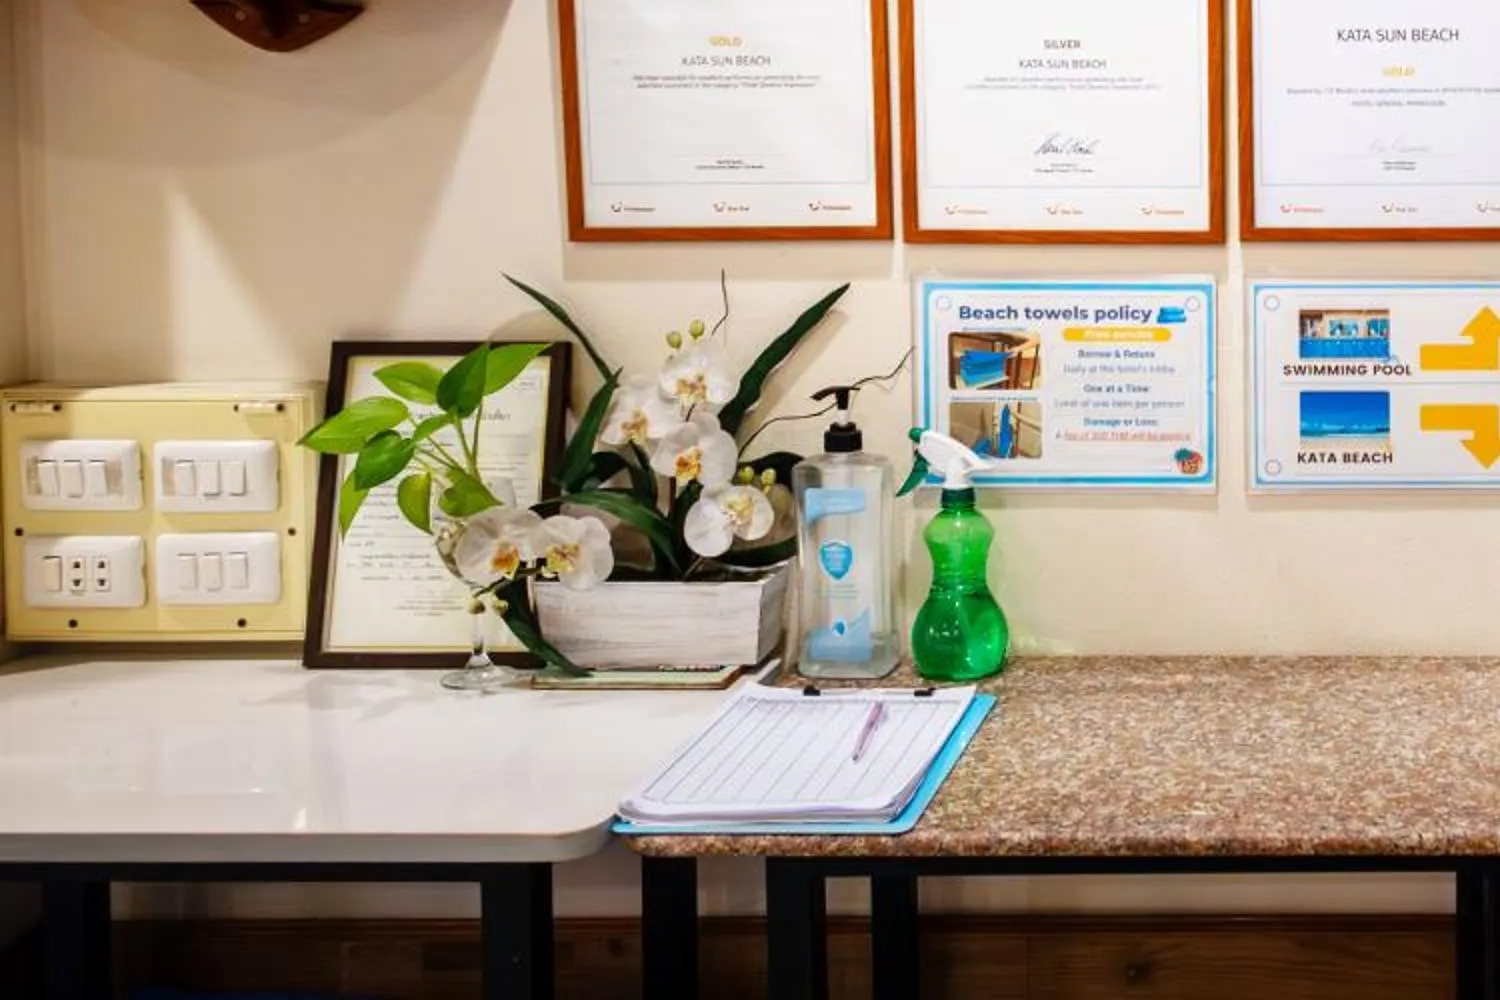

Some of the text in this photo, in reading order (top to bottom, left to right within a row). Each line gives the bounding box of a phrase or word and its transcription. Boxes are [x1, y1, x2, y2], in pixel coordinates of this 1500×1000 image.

[1337, 28, 1459, 42] KATA SUN BEACH
[1043, 39, 1081, 49] SILVER
[711, 56, 733, 66] SUN
[959, 305, 1153, 324] Beach towels policy
[1283, 364, 1412, 377] SWIMMING POOL
[1297, 452, 1393, 464] KATA BEACH
